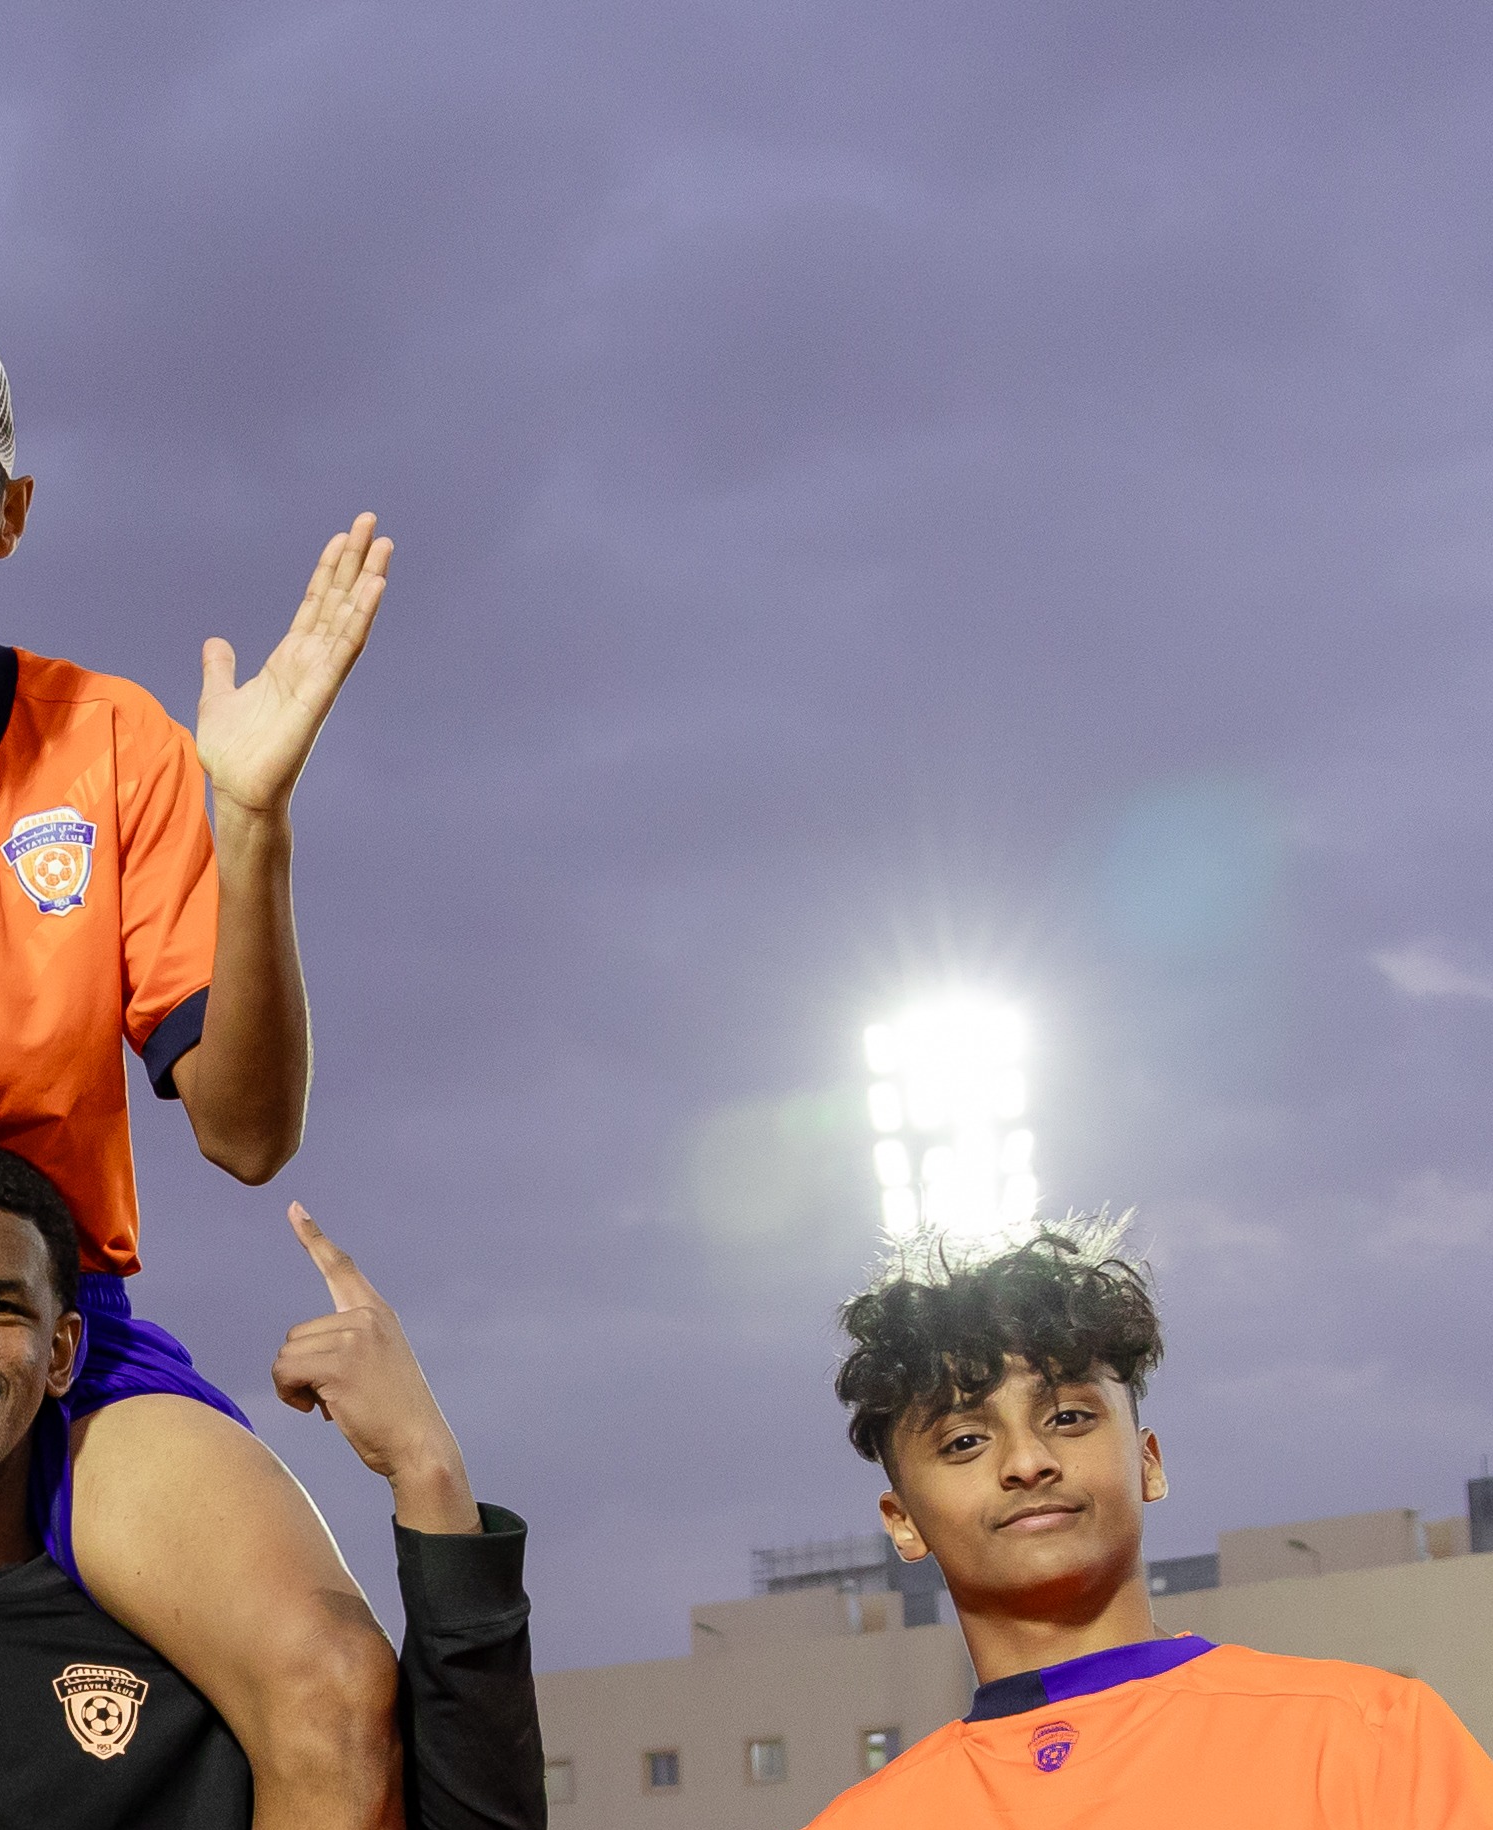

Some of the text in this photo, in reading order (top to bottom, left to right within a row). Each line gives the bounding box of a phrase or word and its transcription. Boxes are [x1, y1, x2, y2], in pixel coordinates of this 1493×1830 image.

[16, 833, 85, 857] ALFAYHA CLUB
[67, 1683, 136, 1698] ALFAYHA CLUB
[96, 1743, 113, 1752] 1953
